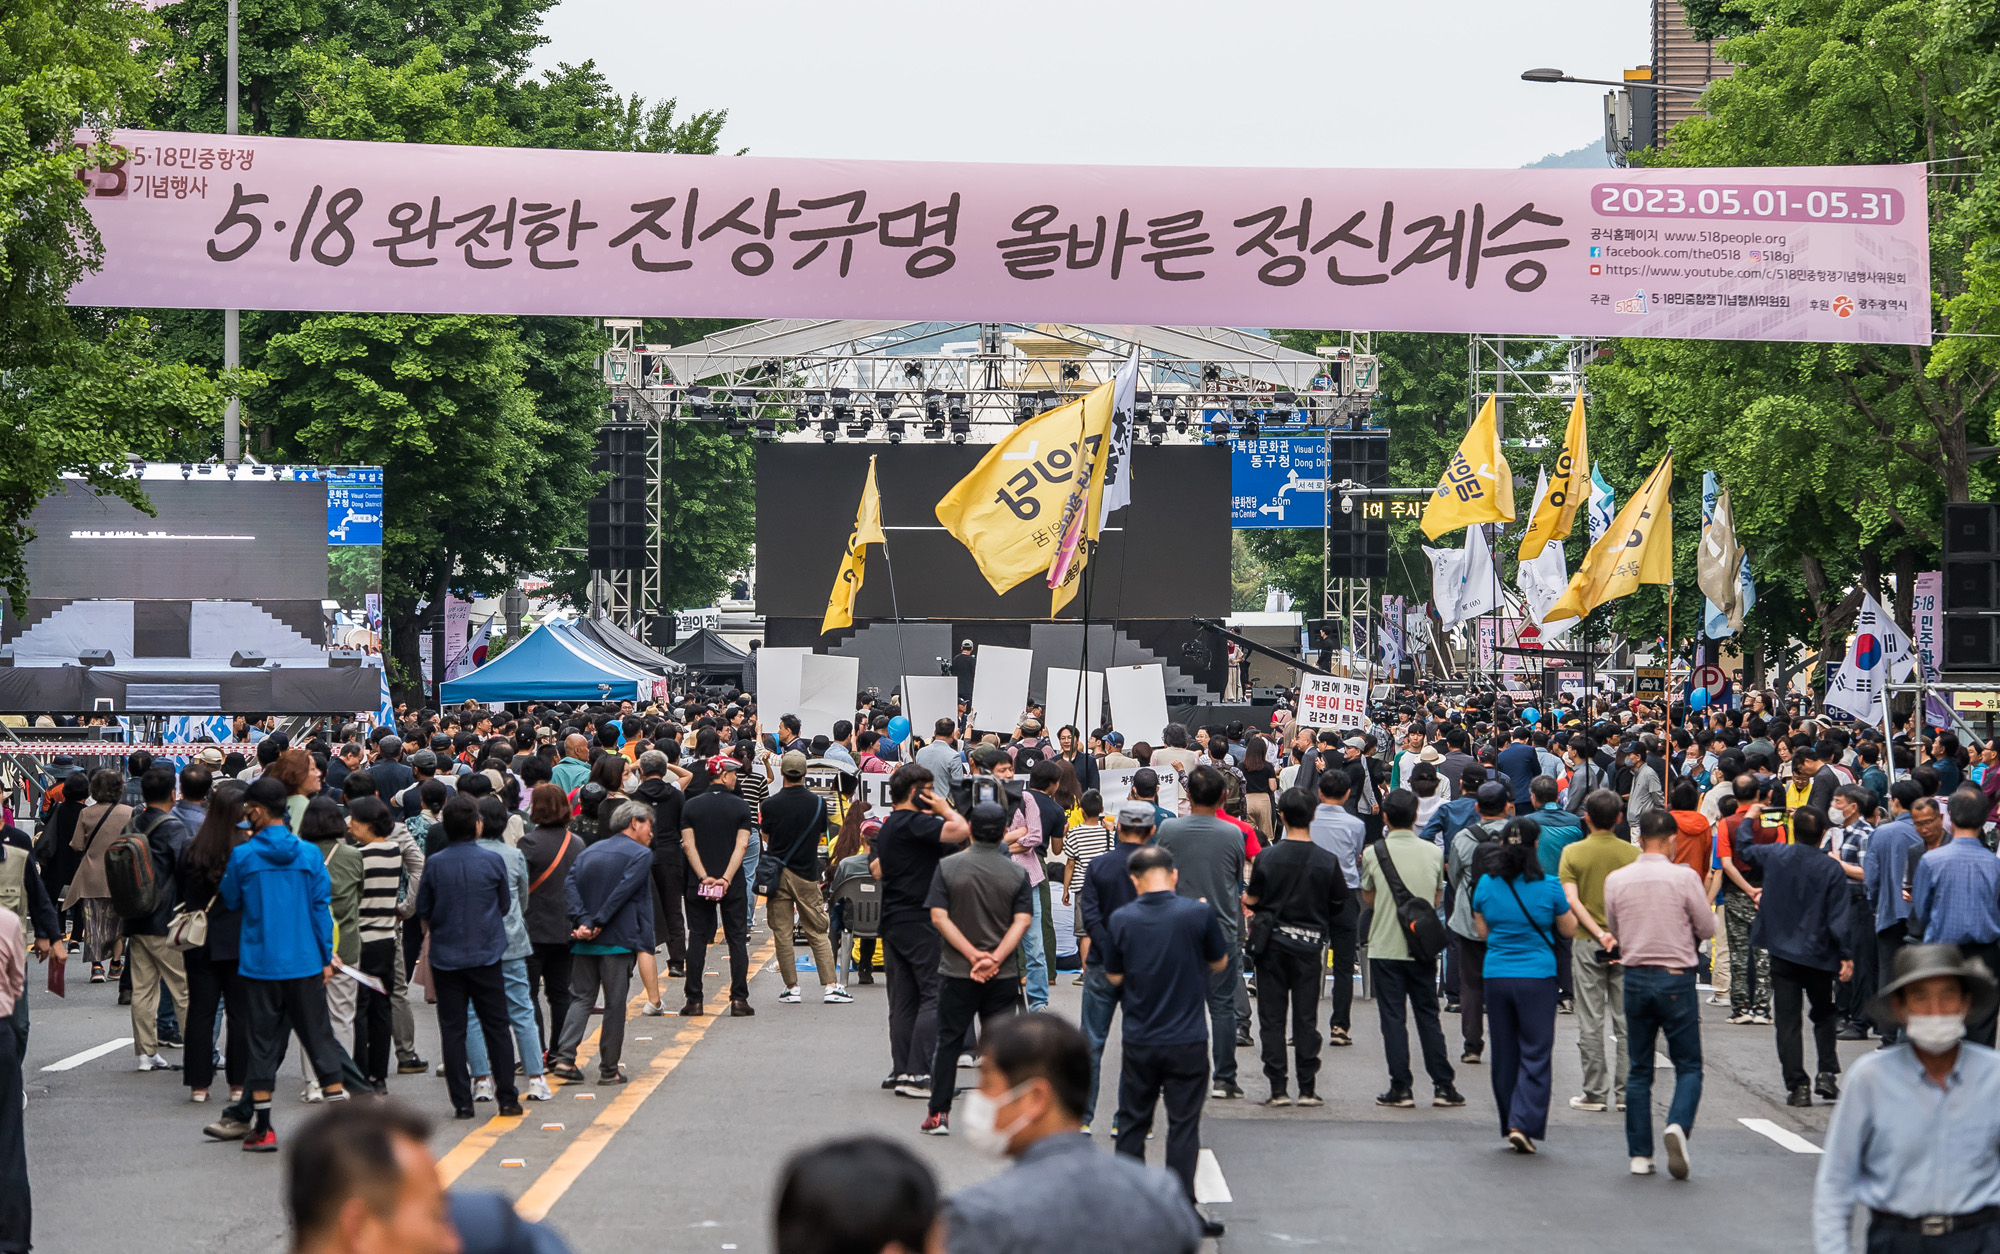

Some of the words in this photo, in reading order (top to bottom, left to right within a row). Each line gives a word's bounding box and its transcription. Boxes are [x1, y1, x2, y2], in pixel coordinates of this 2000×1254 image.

[133, 146, 255, 171] 5·18민중항쟁
[133, 175, 208, 199] 기념행사
[1601, 187, 1892, 220] 2023.05.01-05.31
[207, 182, 364, 264] 5·18
[372, 196, 598, 271] 완전한
[608, 187, 961, 279] 진상규명
[997, 205, 1214, 281] 올바른
[1234, 197, 1571, 293] 정신계승
[1590, 228, 1659, 241] 공식홈페이지
[1664, 231, 1786, 246] www.518people.org
[1606, 246, 1741, 260] facebook.com/the0518
[1762, 250, 1794, 264] 518gj
[1590, 294, 1610, 306] 주관
[1809, 300, 1829, 311] 후원
[1858, 299, 1907, 311] 광주광역시
[1294, 445, 1313, 454] Visual
[1250, 455, 1290, 468] 동구청
[1294, 459, 1313, 469] Dong
[1272, 497, 1290, 505] 50m
[1239, 510, 1257, 518] Center
[1311, 680, 1340, 693] 개검에
[1344, 698, 1364, 712] 타도
[1309, 711, 1338, 724] 김건희
[1342, 714, 1359, 726] 특검
